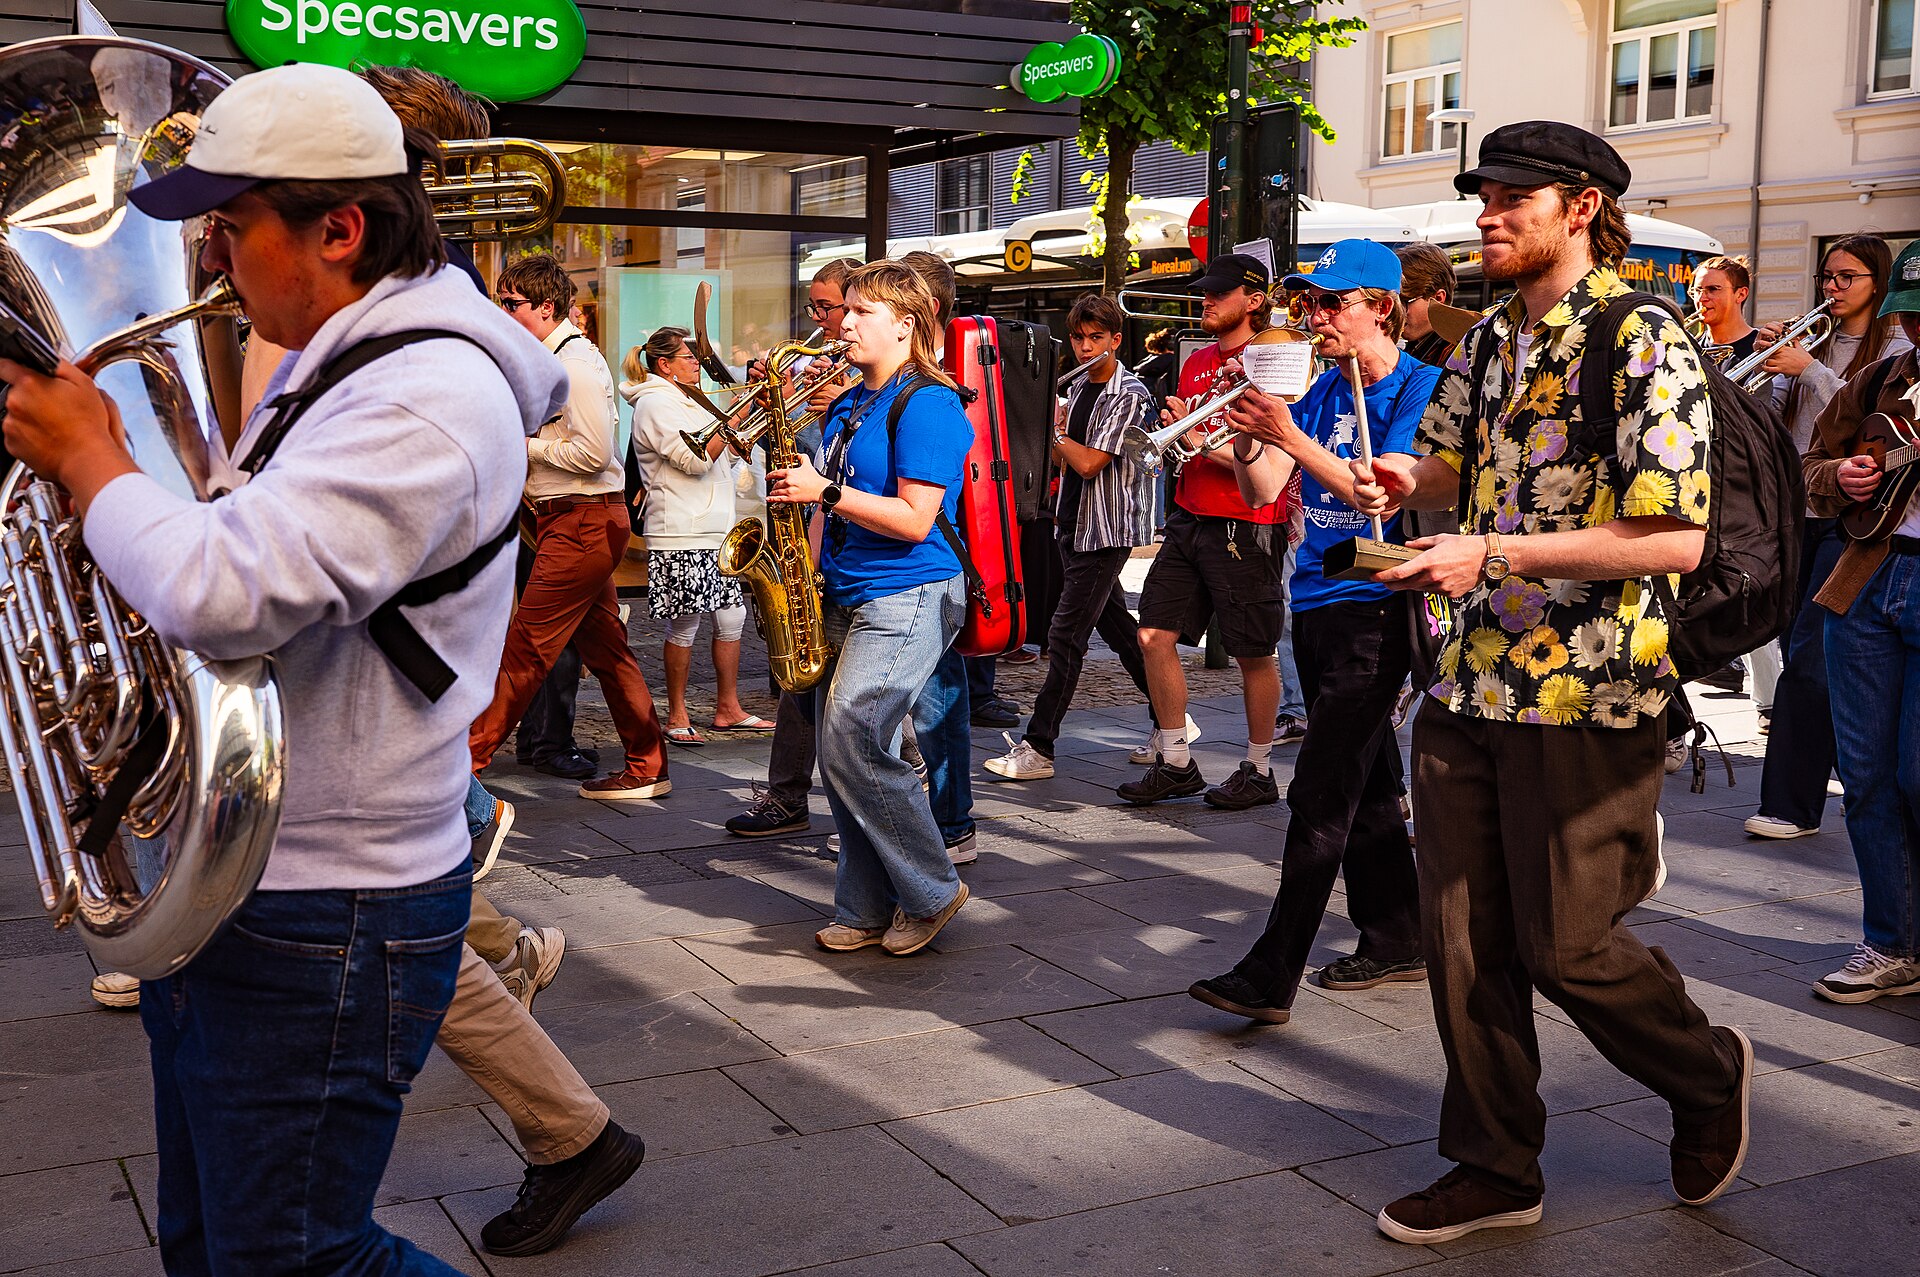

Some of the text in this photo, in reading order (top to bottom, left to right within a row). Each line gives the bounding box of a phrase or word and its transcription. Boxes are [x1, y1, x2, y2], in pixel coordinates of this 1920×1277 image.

[261, 0, 559, 50] Specsavers
[1024, 55, 1093, 85] Specsavers
[1012, 246, 1025, 266] C
[1151, 257, 1192, 274] Boreal.no
[1618, 259, 1653, 281] Lund
[1210, 417, 1228, 427] BEA
